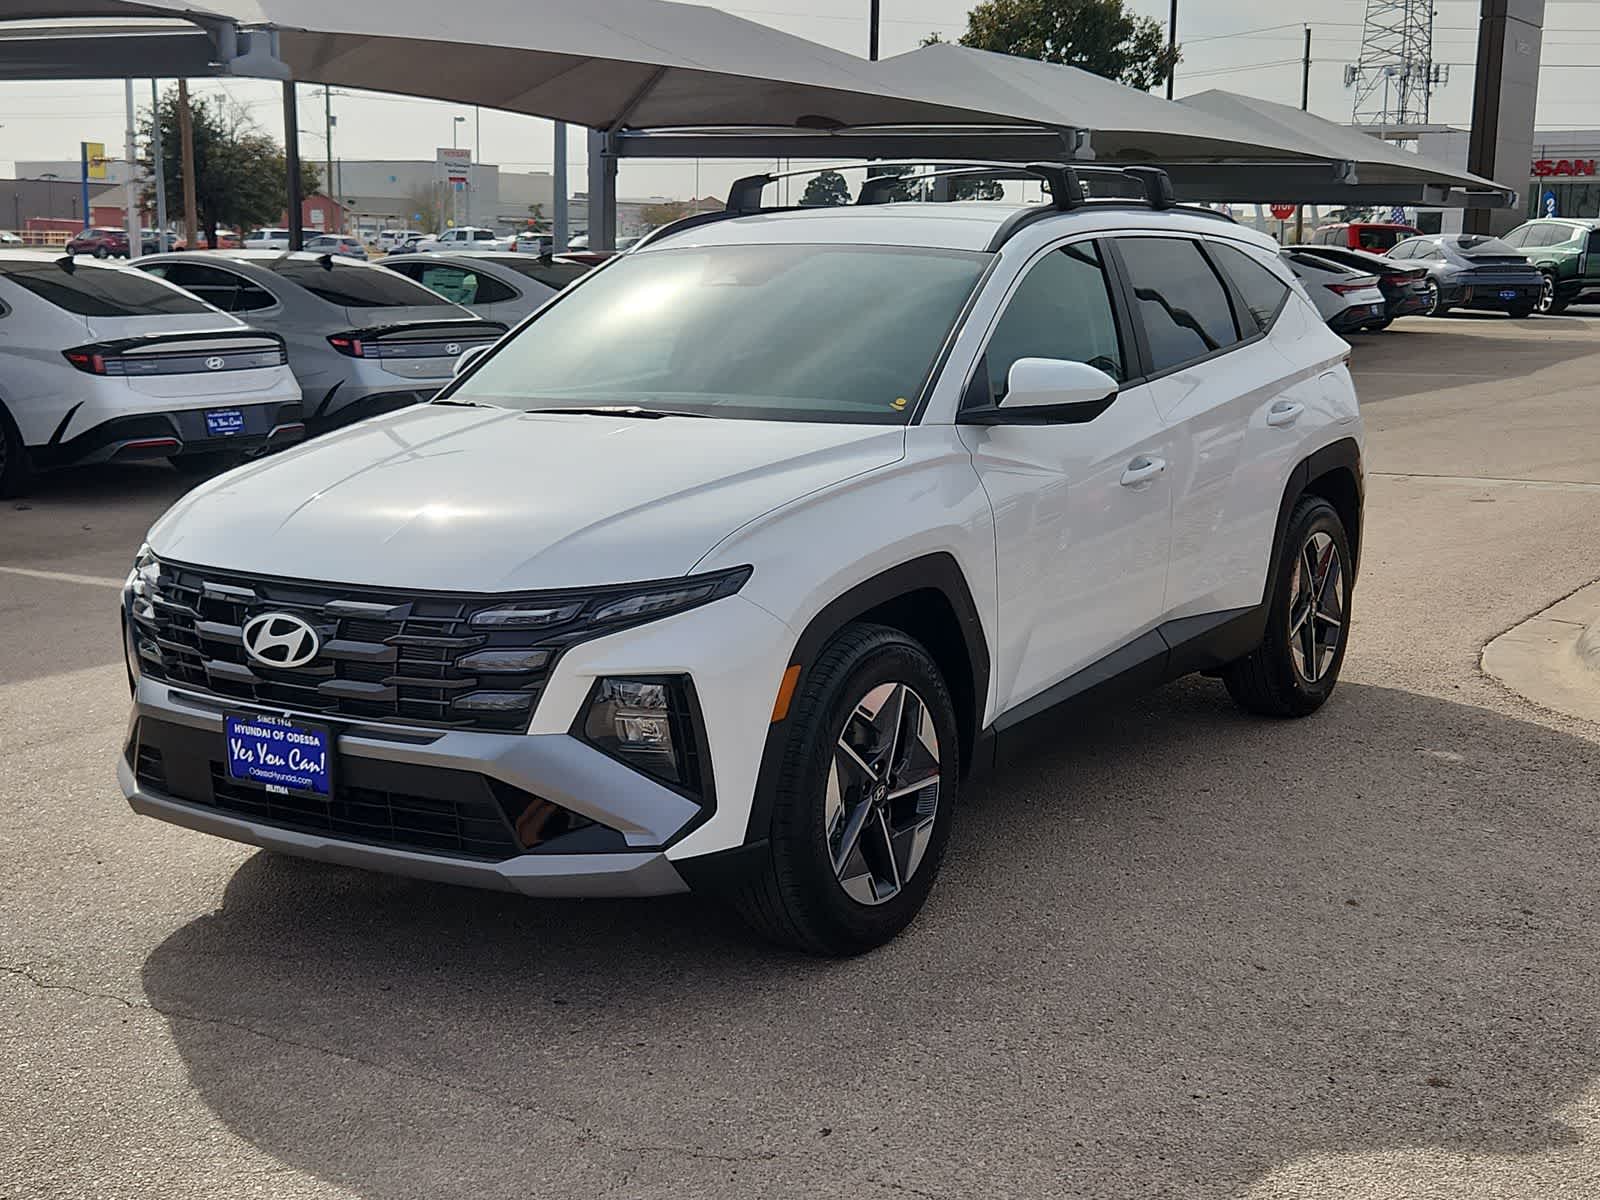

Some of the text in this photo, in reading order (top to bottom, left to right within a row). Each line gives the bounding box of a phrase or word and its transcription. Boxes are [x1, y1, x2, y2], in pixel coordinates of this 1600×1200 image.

[1531, 160, 1595, 176] SAN
[257, 714, 276, 725] SINCE
[234, 724, 321, 747] HYUNDAI OF ODESSA
[231, 738, 326, 776] Yes You Can!
[249, 766, 313, 785] OdessaHyundai.com
